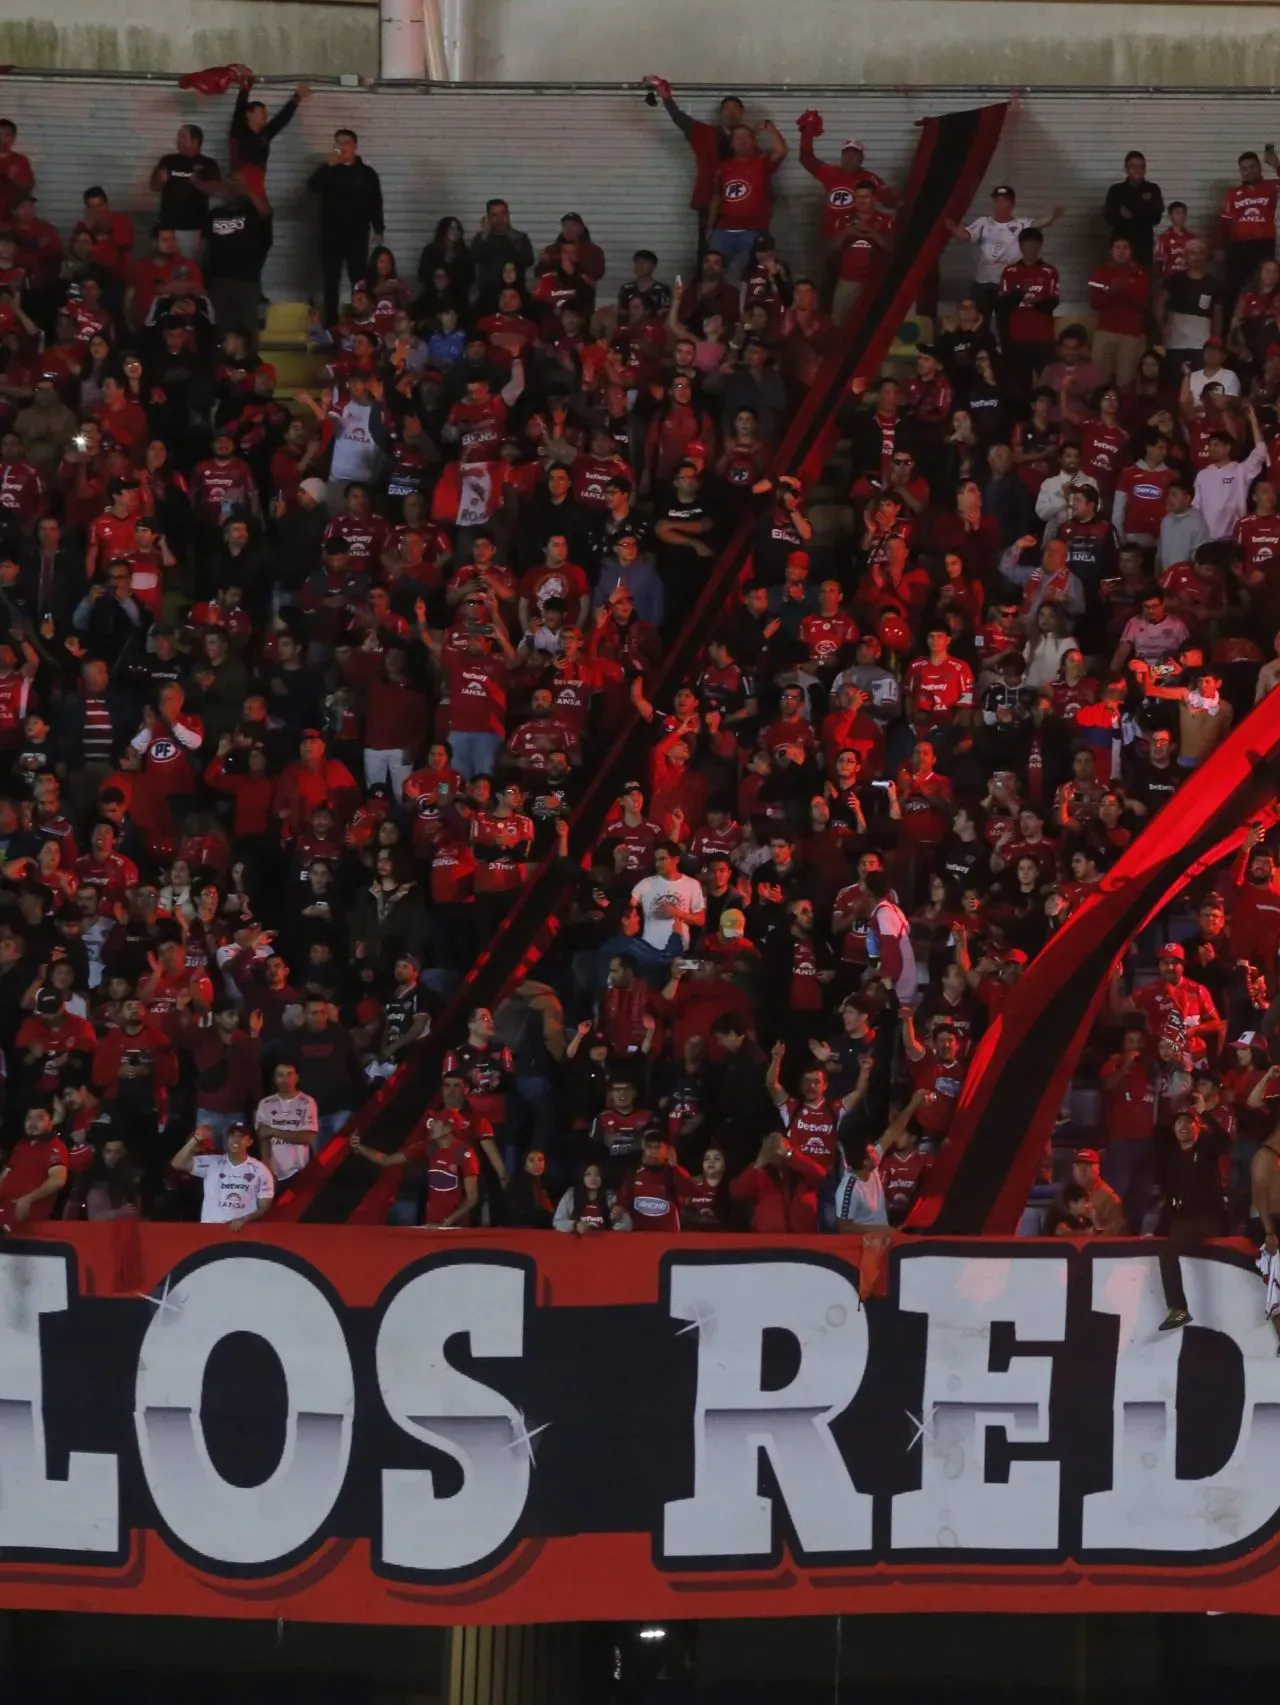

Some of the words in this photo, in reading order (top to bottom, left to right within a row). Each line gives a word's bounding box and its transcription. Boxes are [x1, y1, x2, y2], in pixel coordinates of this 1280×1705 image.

[1235, 197, 1269, 209] betway
[970, 399, 999, 408] betway
[344, 434, 371, 444] IANSA
[1252, 535, 1279, 545] betway
[461, 688, 487, 697] IANSA
[272, 1118, 301, 1127] betway
[797, 1121, 832, 1134] betway
[221, 1183, 249, 1191] betway
[0, 1254, 532, 1572] LOS
